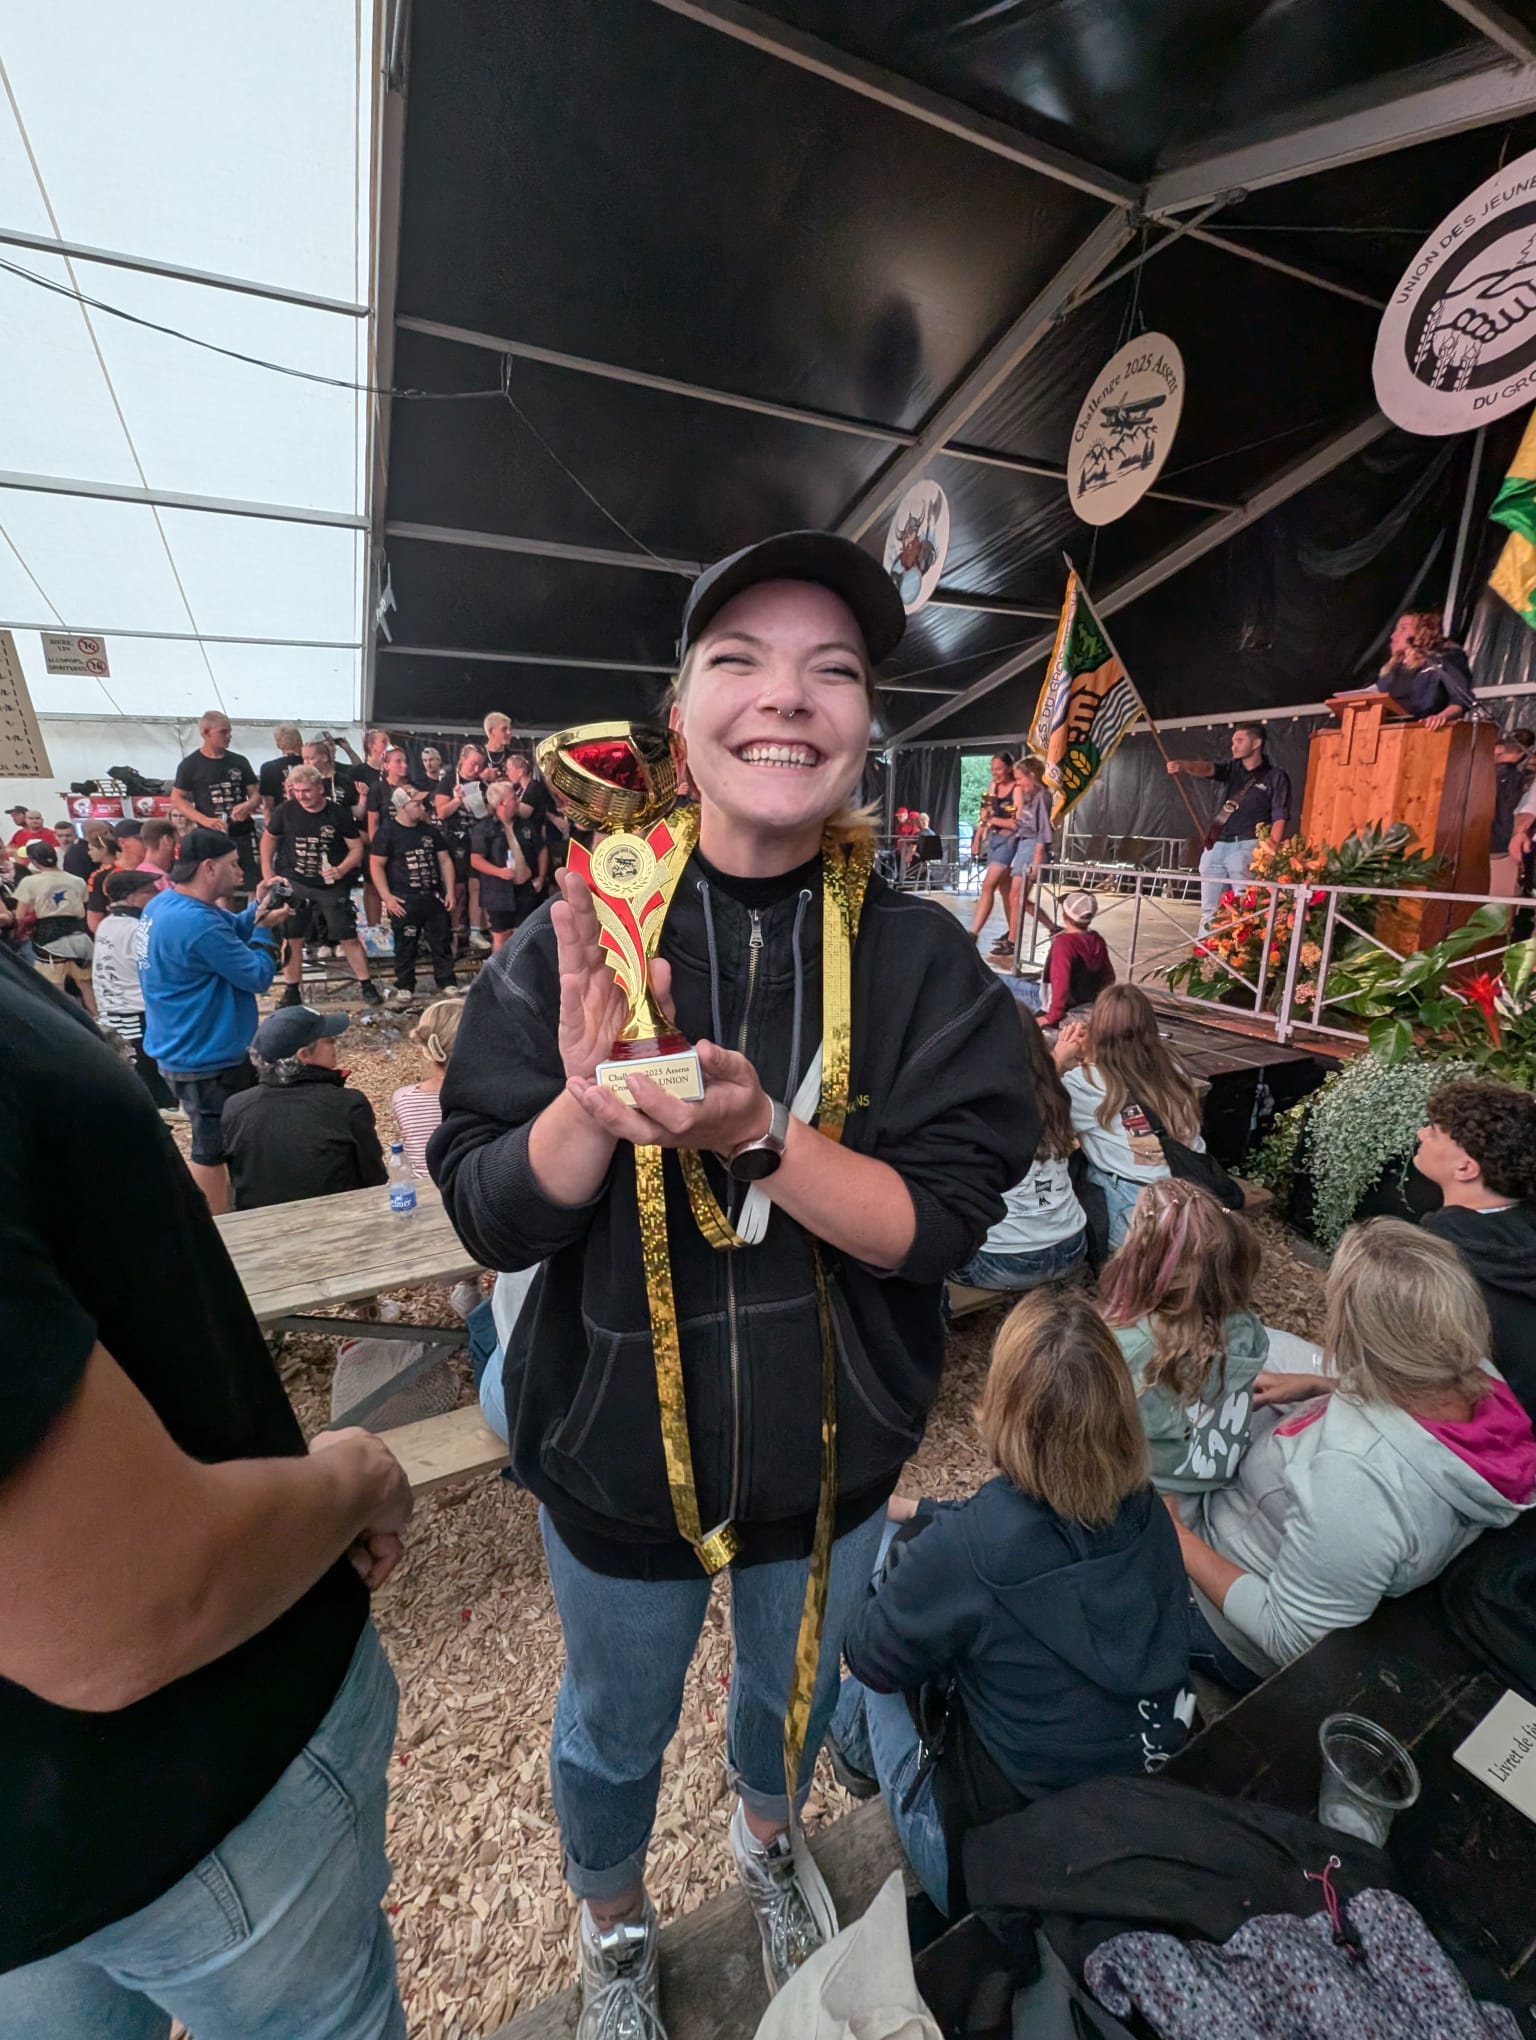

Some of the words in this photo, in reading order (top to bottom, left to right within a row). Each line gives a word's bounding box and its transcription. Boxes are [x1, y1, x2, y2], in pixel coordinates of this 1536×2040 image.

[1396, 251, 1439, 304] UNION
[1440, 214, 1476, 250] DES
[1074, 374, 1121, 443] Challenge
[1124, 353, 1153, 379] 2025
[1152, 354, 1179, 395] Assens
[1472, 392, 1498, 410] DU
[659, 1075, 689, 1086] UNION
[666, 1066, 690, 1075] Assens
[1488, 1749, 1524, 1783] Livret
[1513, 1737, 1534, 1753] de
